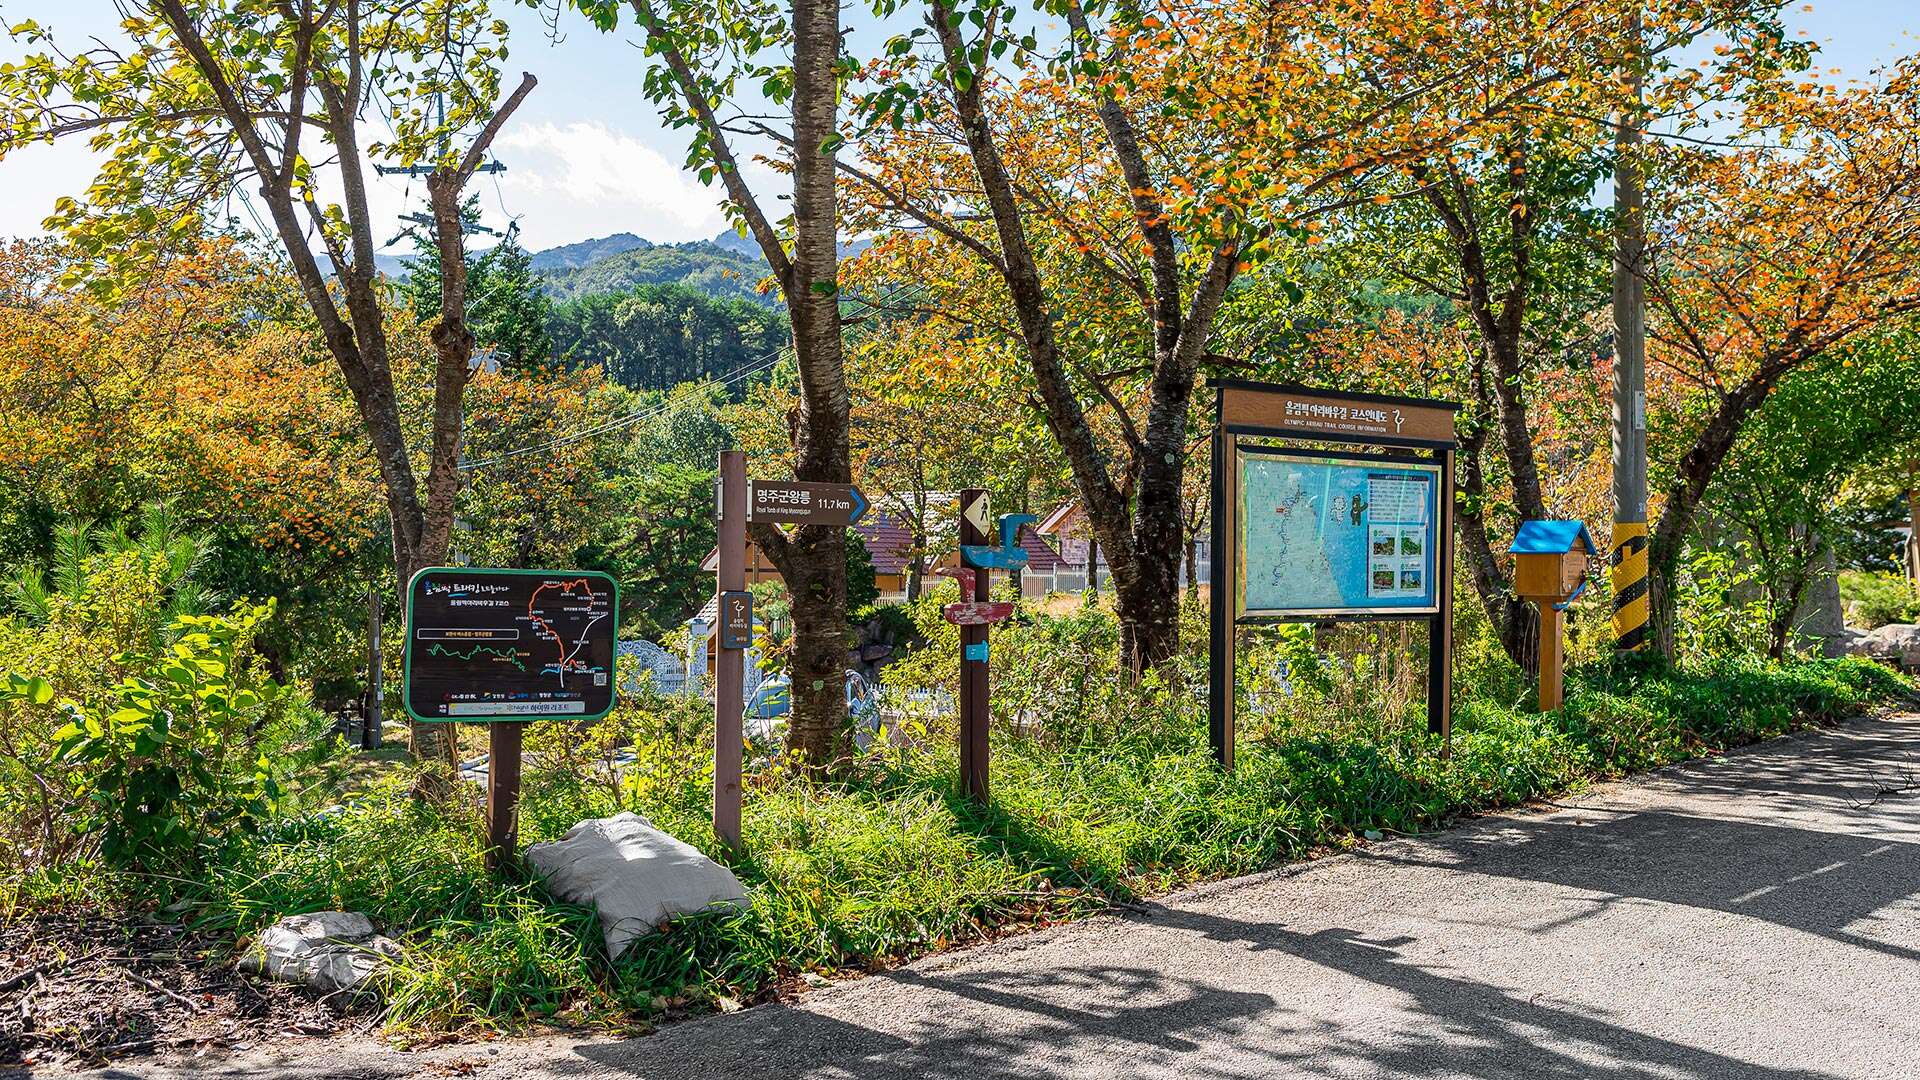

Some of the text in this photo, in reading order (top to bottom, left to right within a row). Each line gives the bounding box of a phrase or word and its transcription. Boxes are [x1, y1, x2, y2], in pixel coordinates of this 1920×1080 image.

[757, 489, 811, 504] 명주군왕릉
[818, 498, 850, 509] 11.7 km
